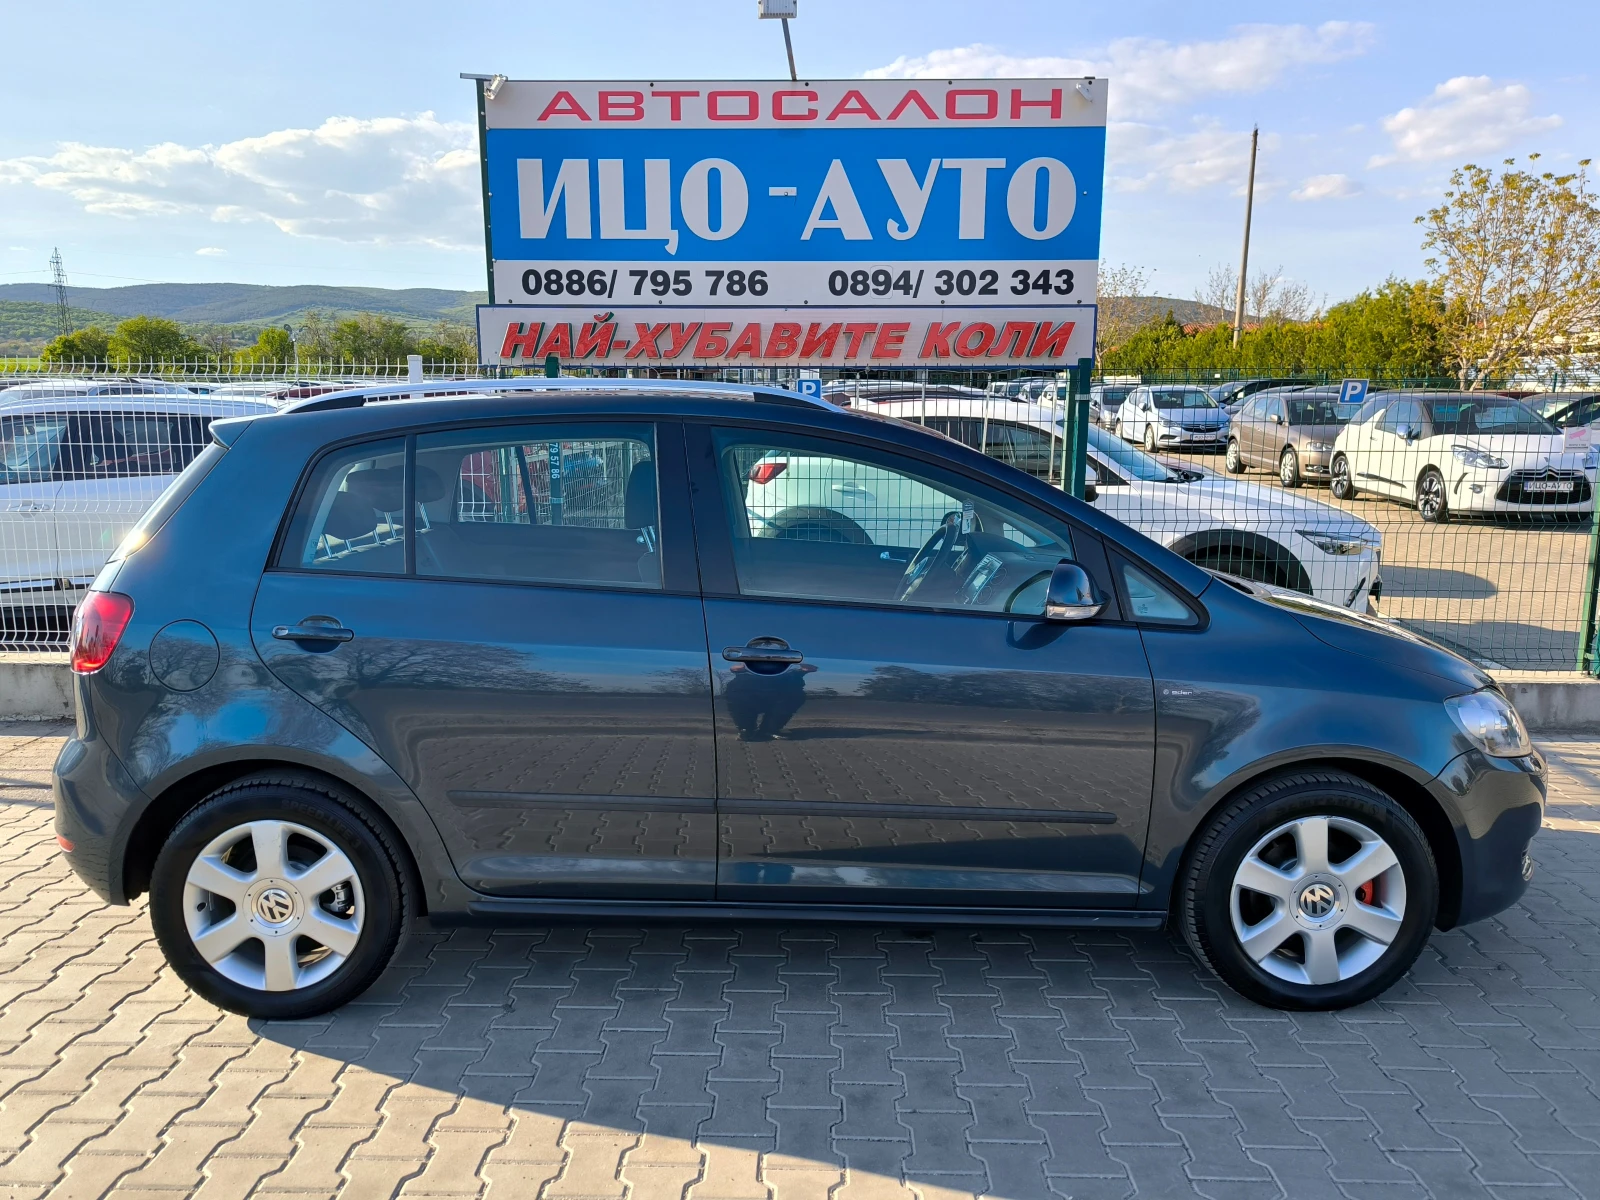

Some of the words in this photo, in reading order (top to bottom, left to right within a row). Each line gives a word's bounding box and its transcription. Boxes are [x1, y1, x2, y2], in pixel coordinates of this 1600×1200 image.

[538, 88, 1063, 122] АВТОСАЛОН
[521, 268, 618, 299] 0886/
[629, 269, 693, 297] 795
[705, 269, 769, 297] 786
[828, 269, 925, 299] 0894/
[934, 269, 999, 297] 302
[1010, 268, 1075, 297] 343
[499, 311, 911, 360] НАЙ-ХУБАВИТЕ
[920, 320, 1076, 359] КОЛИ
[802, 381, 817, 395] P
[1345, 381, 1362, 401] P
